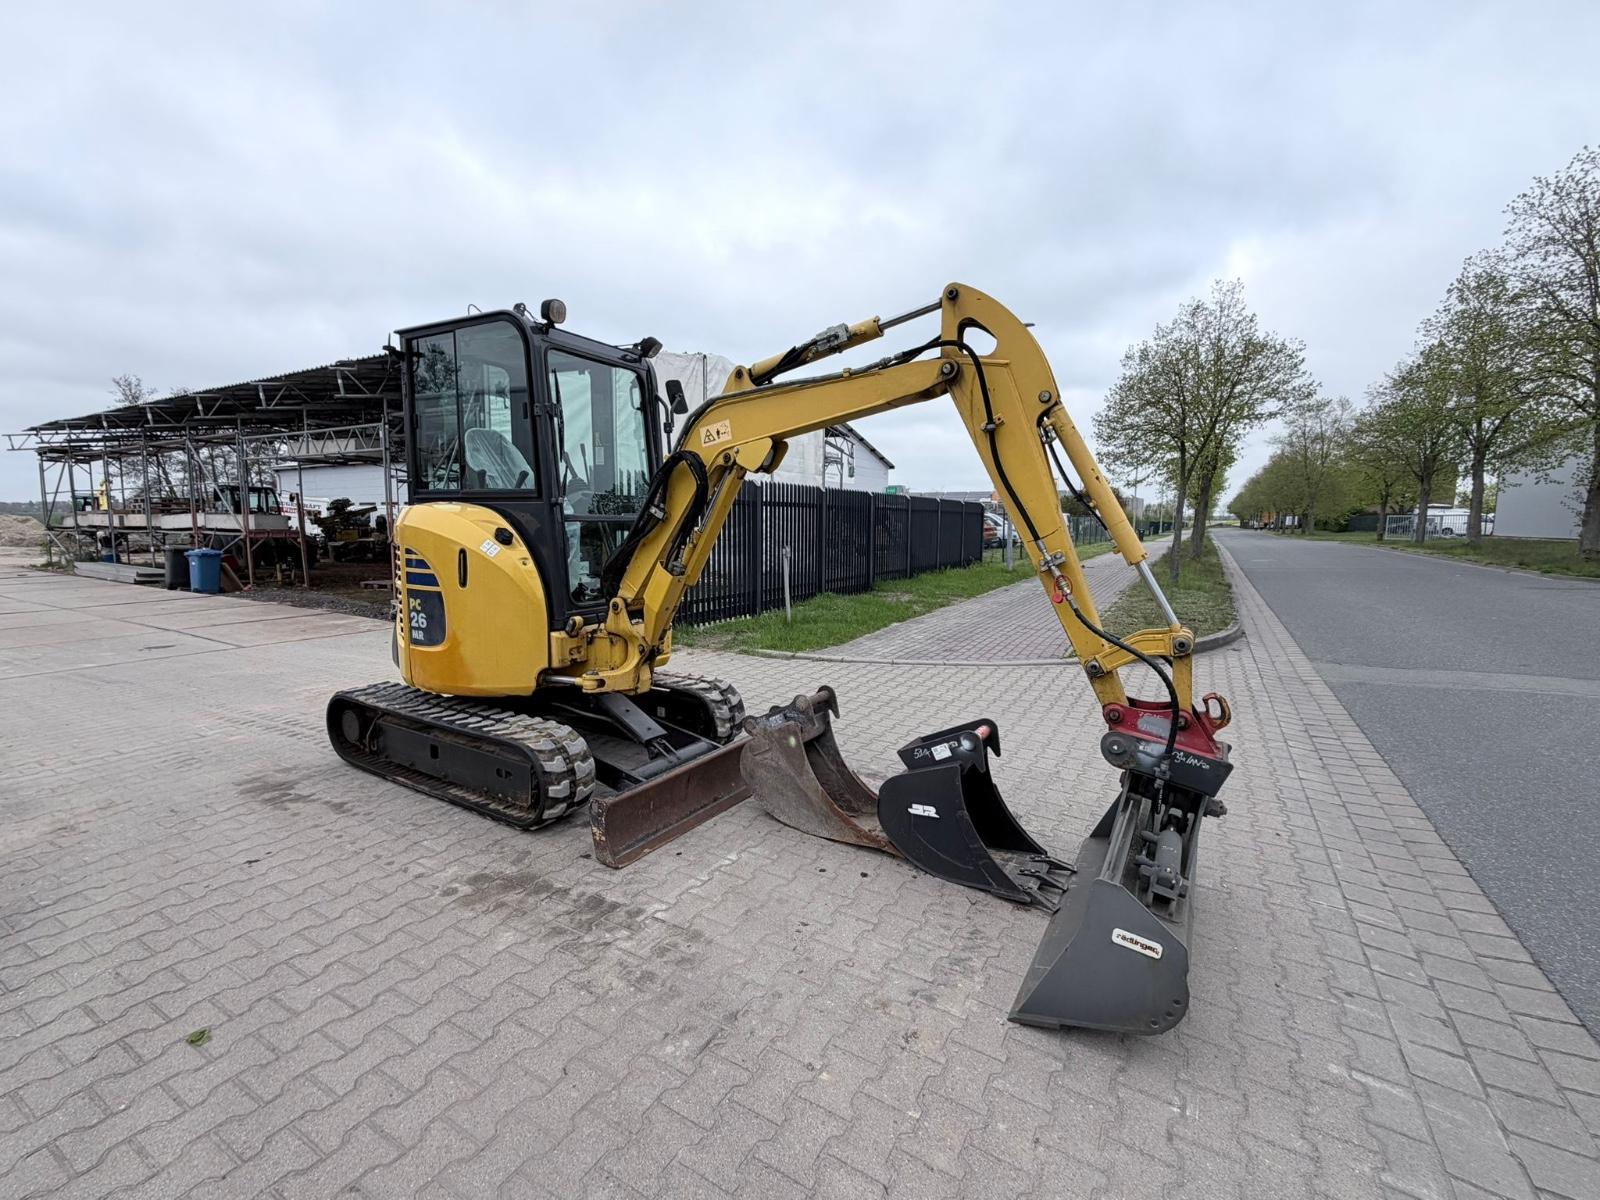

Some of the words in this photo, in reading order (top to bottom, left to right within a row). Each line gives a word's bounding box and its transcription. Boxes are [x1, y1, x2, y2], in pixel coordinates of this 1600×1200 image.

[410, 598, 421, 610] PC
[410, 612, 427, 628] 26
[412, 629, 424, 640] MR
